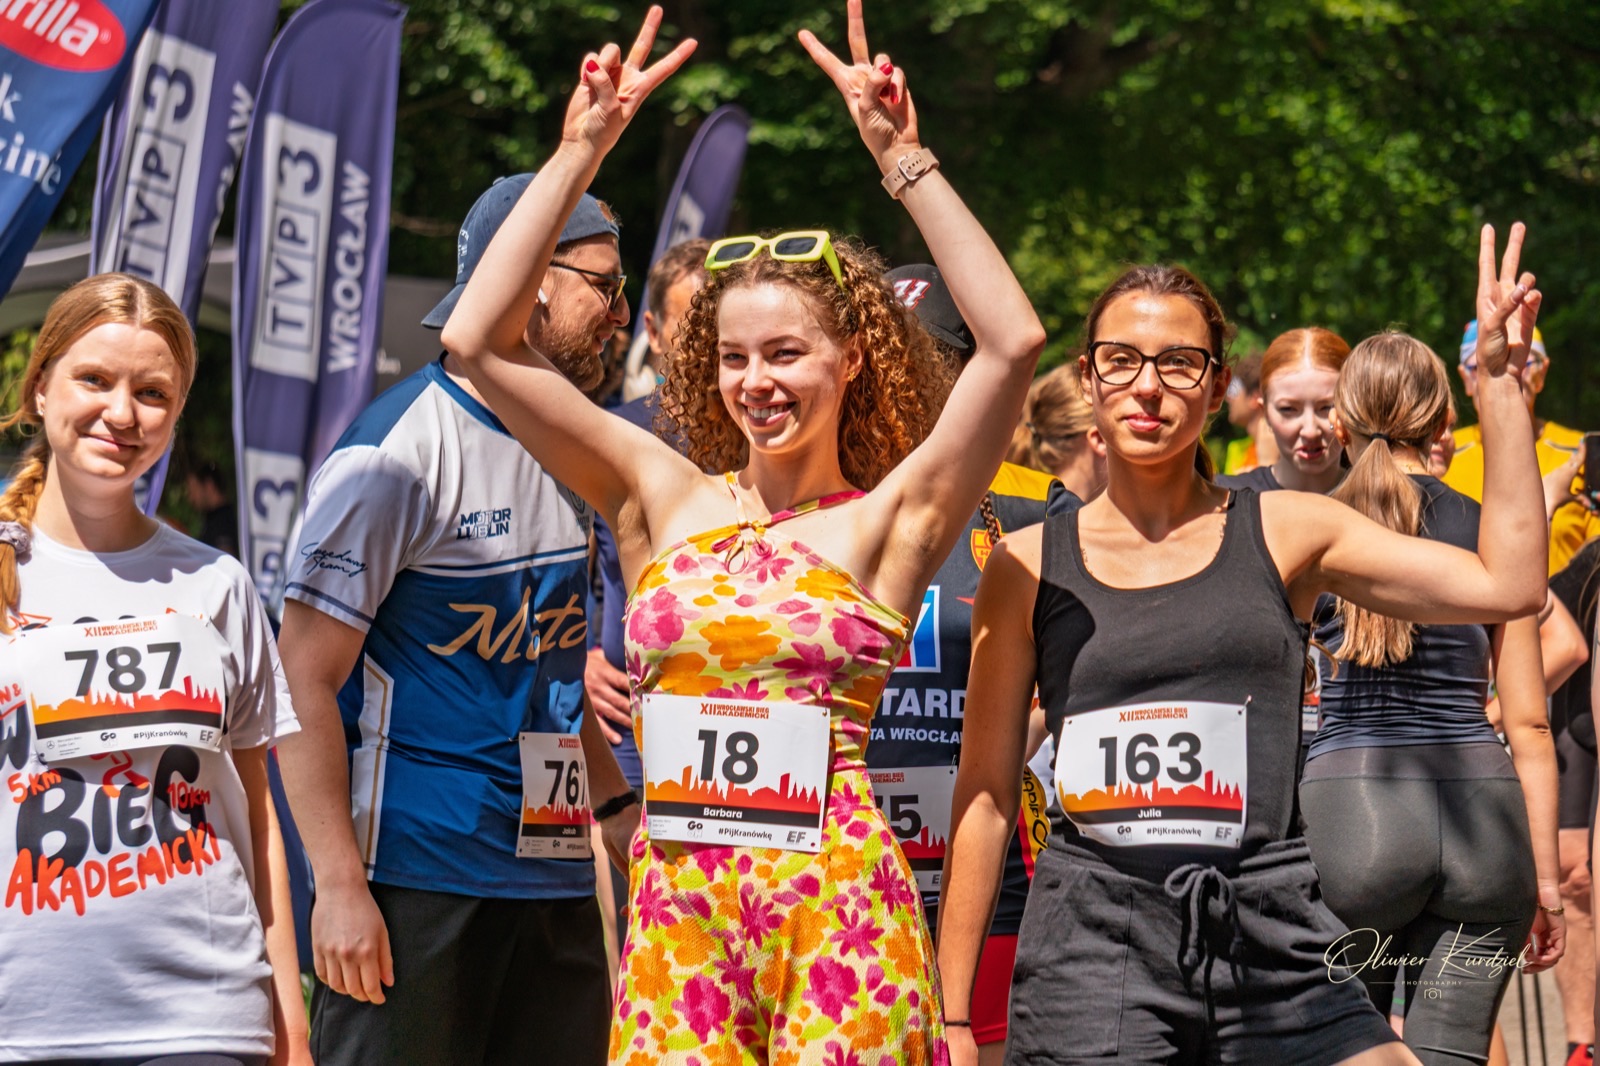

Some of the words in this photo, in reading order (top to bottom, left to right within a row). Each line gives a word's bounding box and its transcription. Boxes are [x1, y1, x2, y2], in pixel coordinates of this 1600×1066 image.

[0, 0, 99, 57] rilla
[327, 161, 371, 373] WROCŁAW
[460, 508, 511, 527] MOTOR
[456, 522, 509, 541] LUBLIN
[84, 626, 102, 638] XII
[64, 642, 182, 697] 787
[700, 703, 716, 715] XII
[717, 710, 769, 719] AKADEMICKI
[1119, 711, 1134, 722] XII
[1135, 712, 1188, 720] AKADEMICKI
[100, 732, 116, 741] Go
[133, 730, 188, 739] #PijKranówkę
[200, 729, 214, 742] EF
[890, 728, 963, 744] WROCŁA
[698, 729, 759, 784] 18
[1099, 732, 1202, 787] 163
[16, 744, 208, 884] BIEG
[703, 807, 743, 819] Barbara
[1137, 808, 1162, 818] Julia
[687, 820, 703, 830] Go
[1117, 825, 1132, 835] Go
[718, 828, 772, 841] #PijKranówkę
[786, 830, 807, 844] EF
[1147, 827, 1202, 837] #PijKranówkę
[1215, 826, 1232, 839] EF
[5, 822, 222, 917] AKADEMICKI
[931, 874, 943, 885] E
